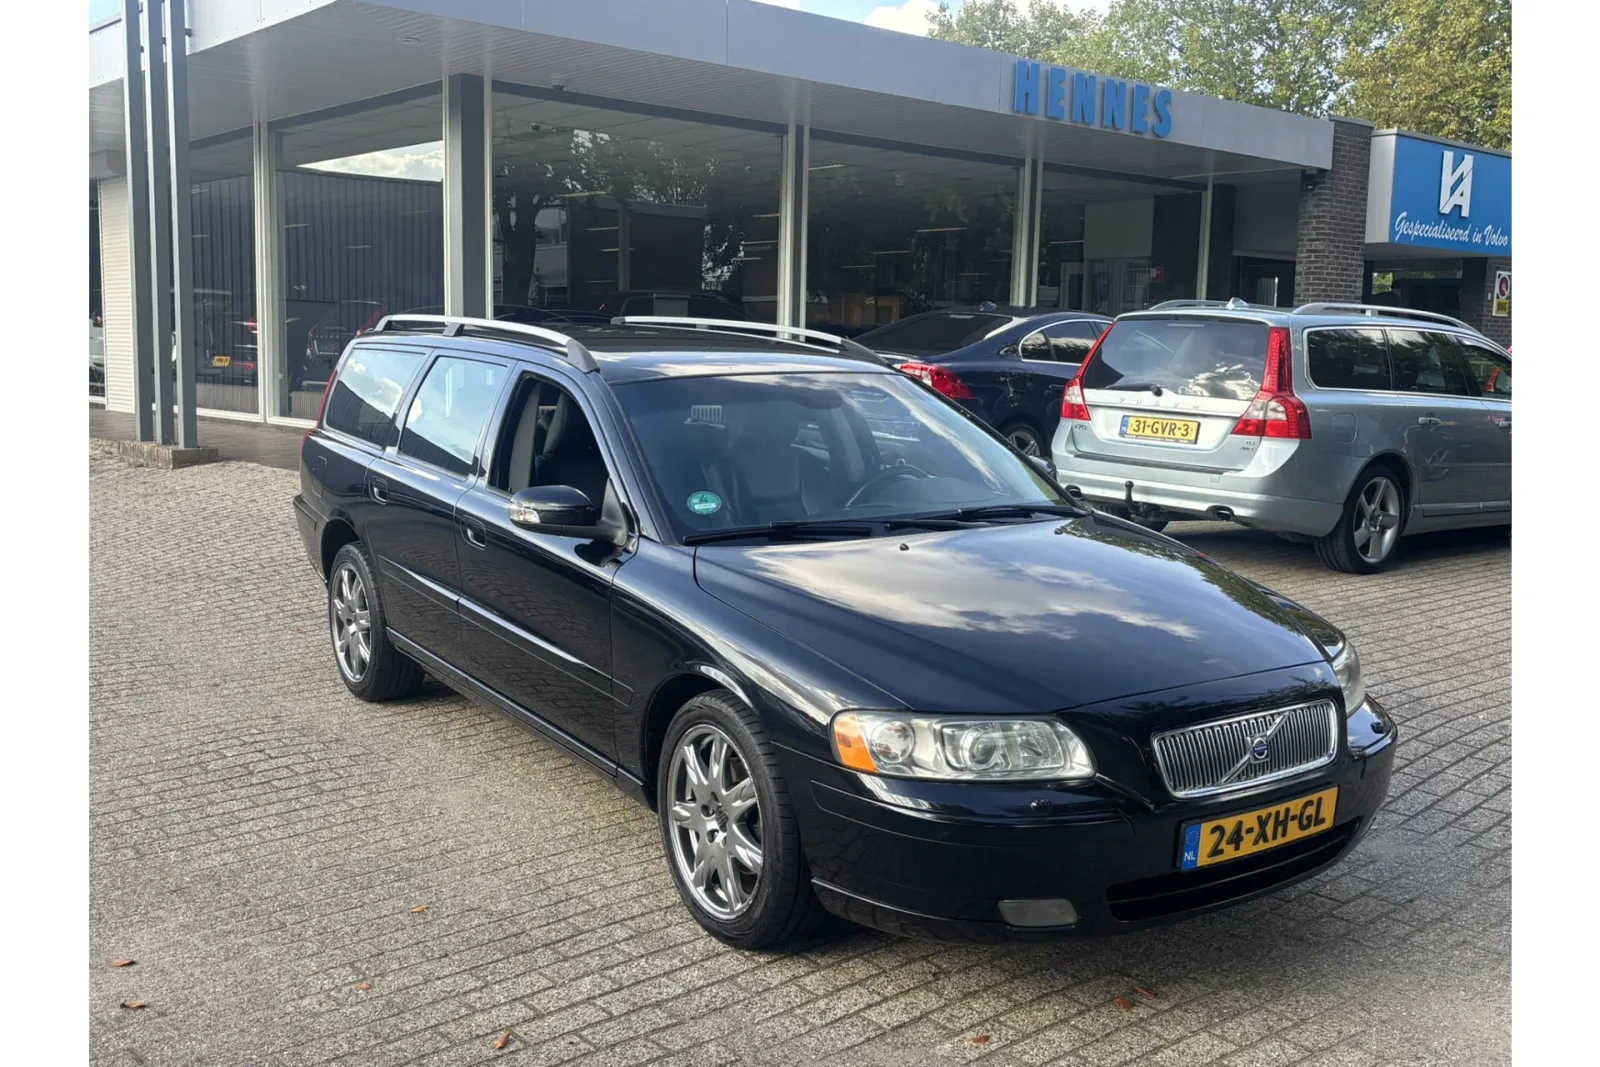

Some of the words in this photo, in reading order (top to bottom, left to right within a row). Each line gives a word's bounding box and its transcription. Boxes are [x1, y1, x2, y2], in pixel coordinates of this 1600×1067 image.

[1014, 60, 1172, 138] HENNES
[1395, 211, 1472, 242] Gespecialiseerd
[1472, 227, 1482, 244] in
[1484, 224, 1508, 247] Volvo
[1132, 419, 1190, 438] 31-GVR-3
[1207, 796, 1326, 858] 24-XH-GL
[1184, 850, 1196, 861] NL
